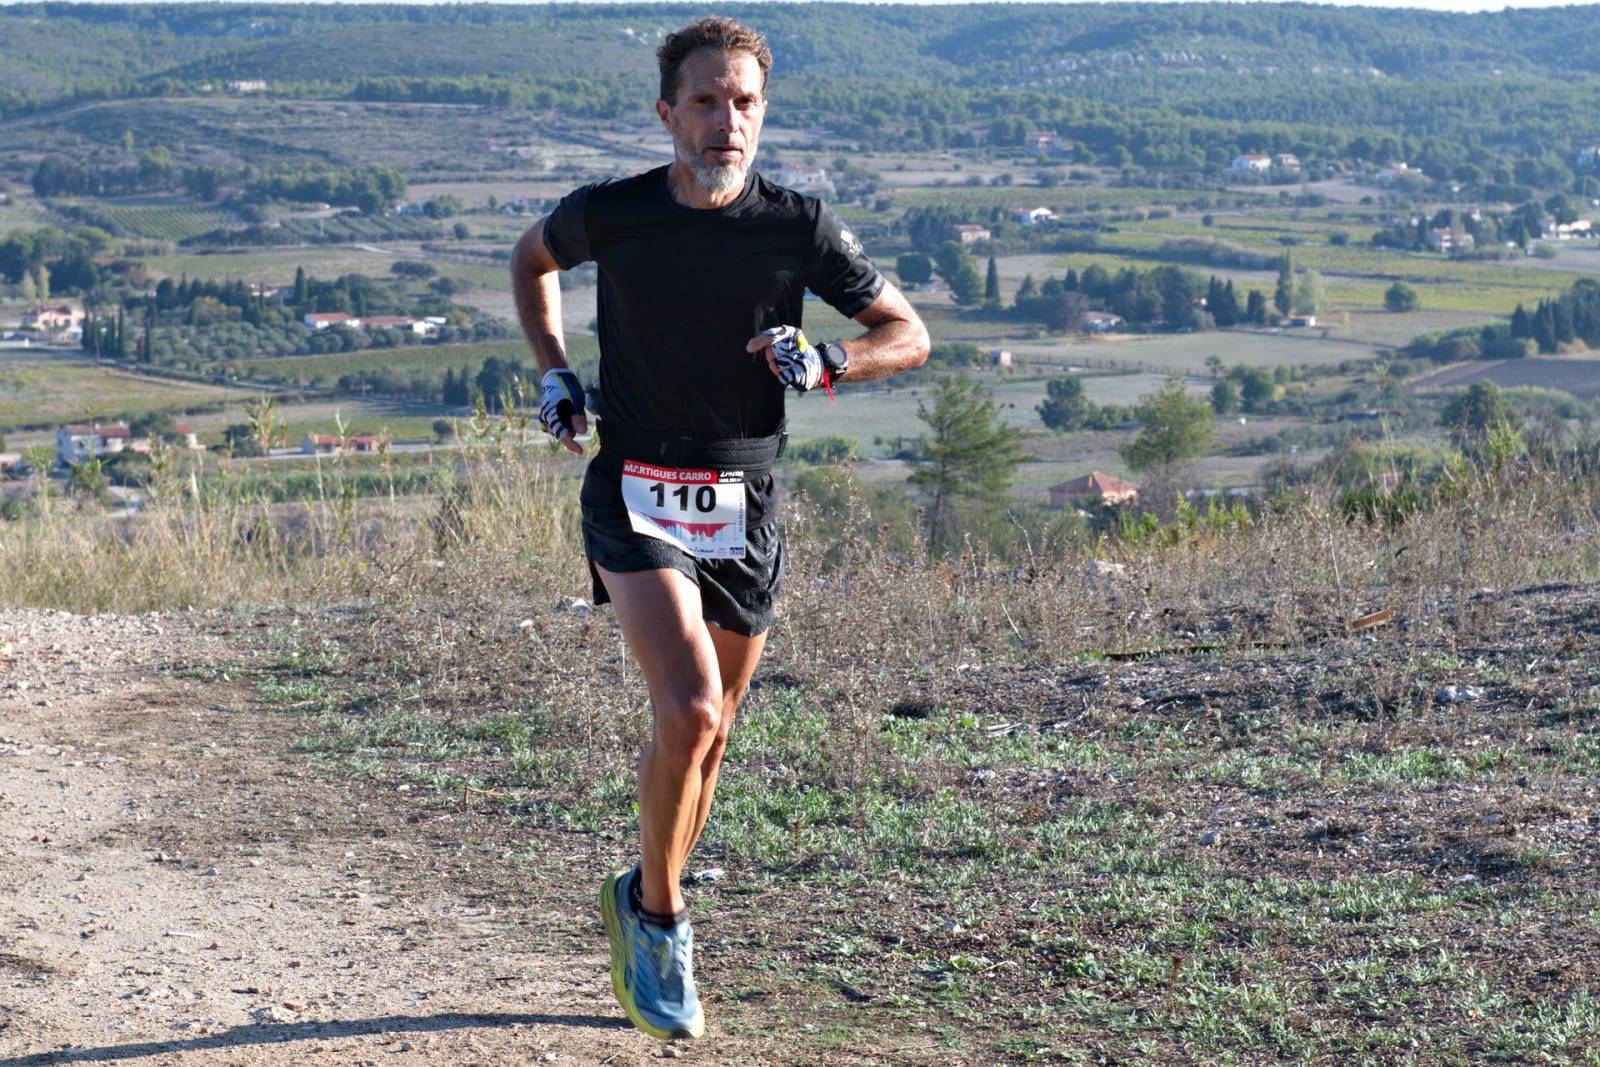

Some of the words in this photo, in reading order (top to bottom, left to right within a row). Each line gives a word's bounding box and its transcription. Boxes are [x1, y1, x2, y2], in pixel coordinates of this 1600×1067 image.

[624, 464, 677, 480] MARTIGUES
[679, 471, 712, 481] CARRO
[650, 482, 717, 513] 110
